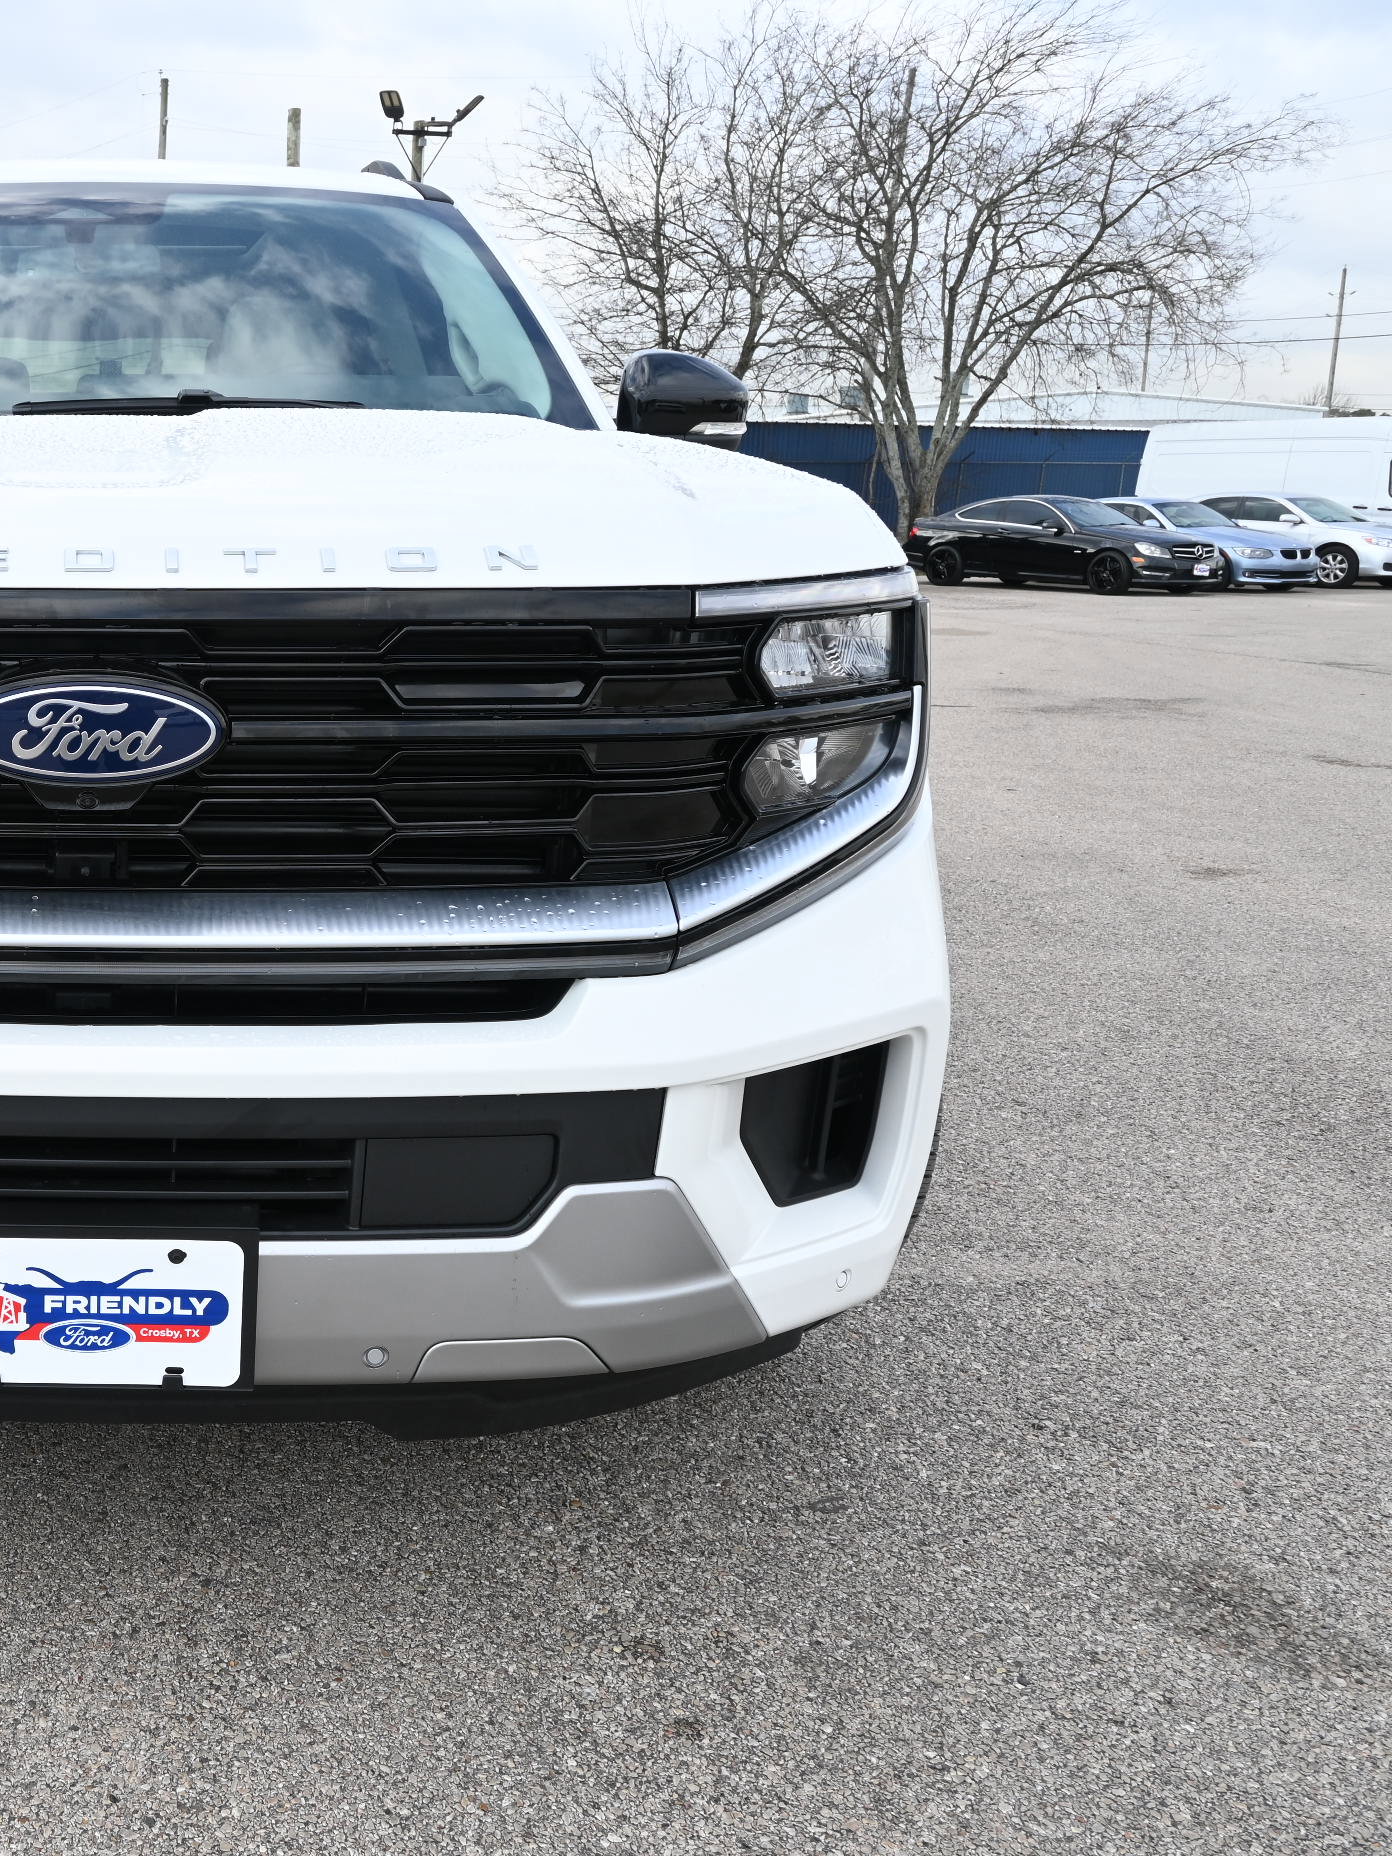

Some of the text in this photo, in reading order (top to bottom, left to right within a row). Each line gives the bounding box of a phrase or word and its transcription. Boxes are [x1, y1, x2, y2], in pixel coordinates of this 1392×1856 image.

[11, 698, 168, 762] Ford
[44, 1294, 213, 1316] FRIENDLY
[59, 1324, 113, 1348] Ford
[139, 1327, 201, 1340] Crosby, TX
